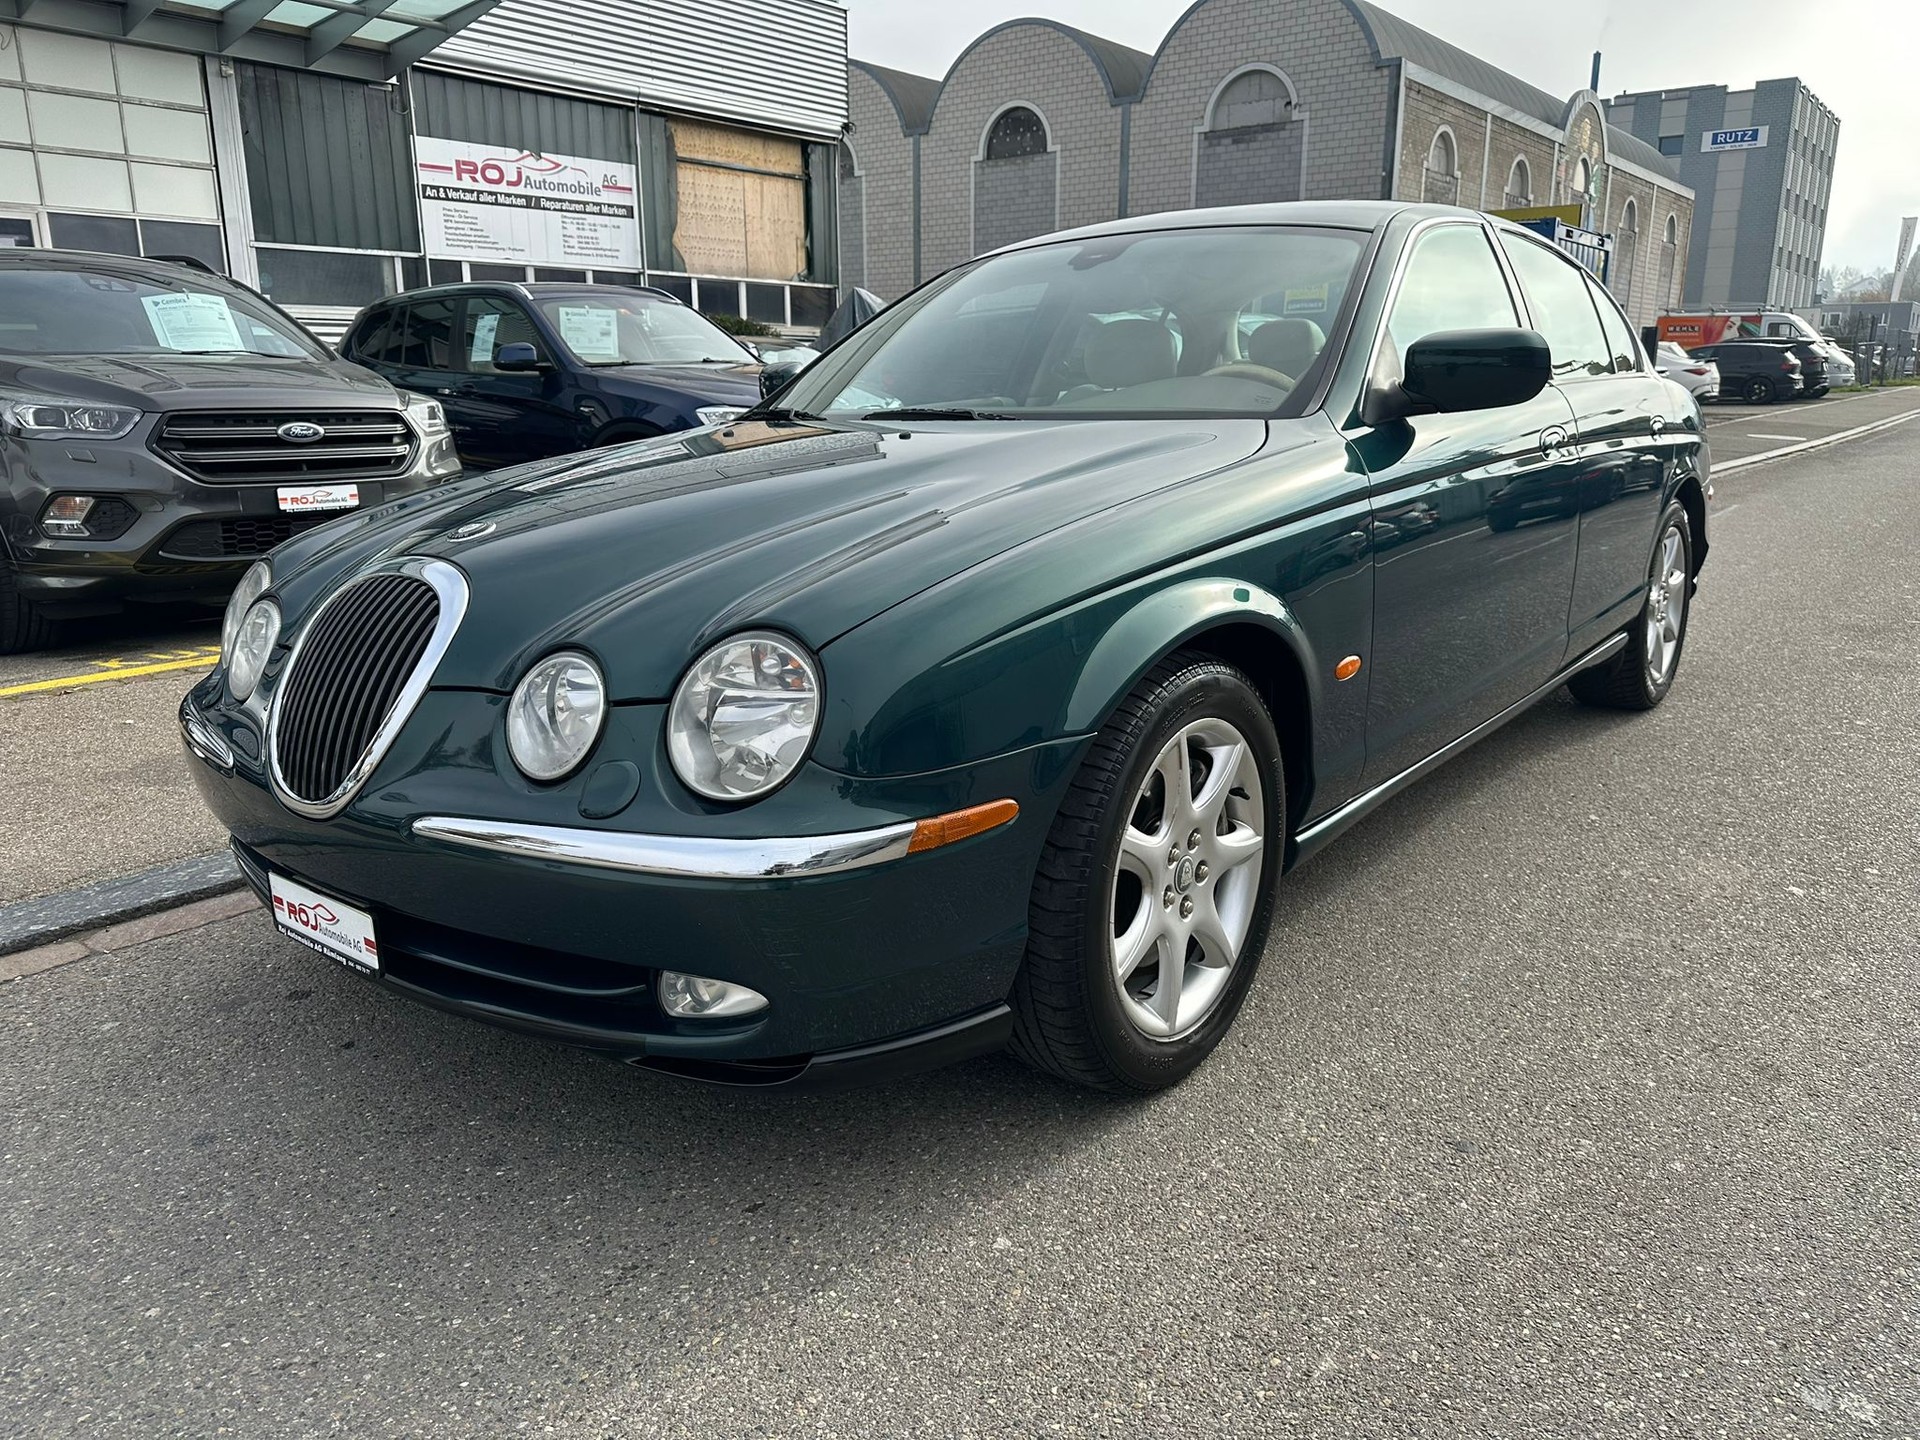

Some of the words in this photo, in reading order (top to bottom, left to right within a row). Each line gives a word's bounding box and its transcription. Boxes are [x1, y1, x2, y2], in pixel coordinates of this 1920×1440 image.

[1717, 131, 1753, 143] RUTZ
[455, 159, 522, 187] ROJ
[524, 175, 602, 197] Automobile
[602, 173, 618, 186] AG
[425, 186, 437, 197] An
[438, 188, 446, 198] &
[446, 188, 478, 202] Verkauf
[479, 192, 496, 203] aller
[497, 193, 527, 206] Marken
[540, 198, 585, 212] Reparaturen
[585, 204, 600, 214] aller
[601, 204, 627, 216] Marken
[290, 425, 313, 437] Ford
[290, 495, 316, 506] ROJ
[286, 901, 319, 932] ROJ
[318, 923, 353, 949] Automobile
[352, 937, 362, 953] AG
[287, 929, 314, 949] Automobile
[314, 943, 323, 952] AG
